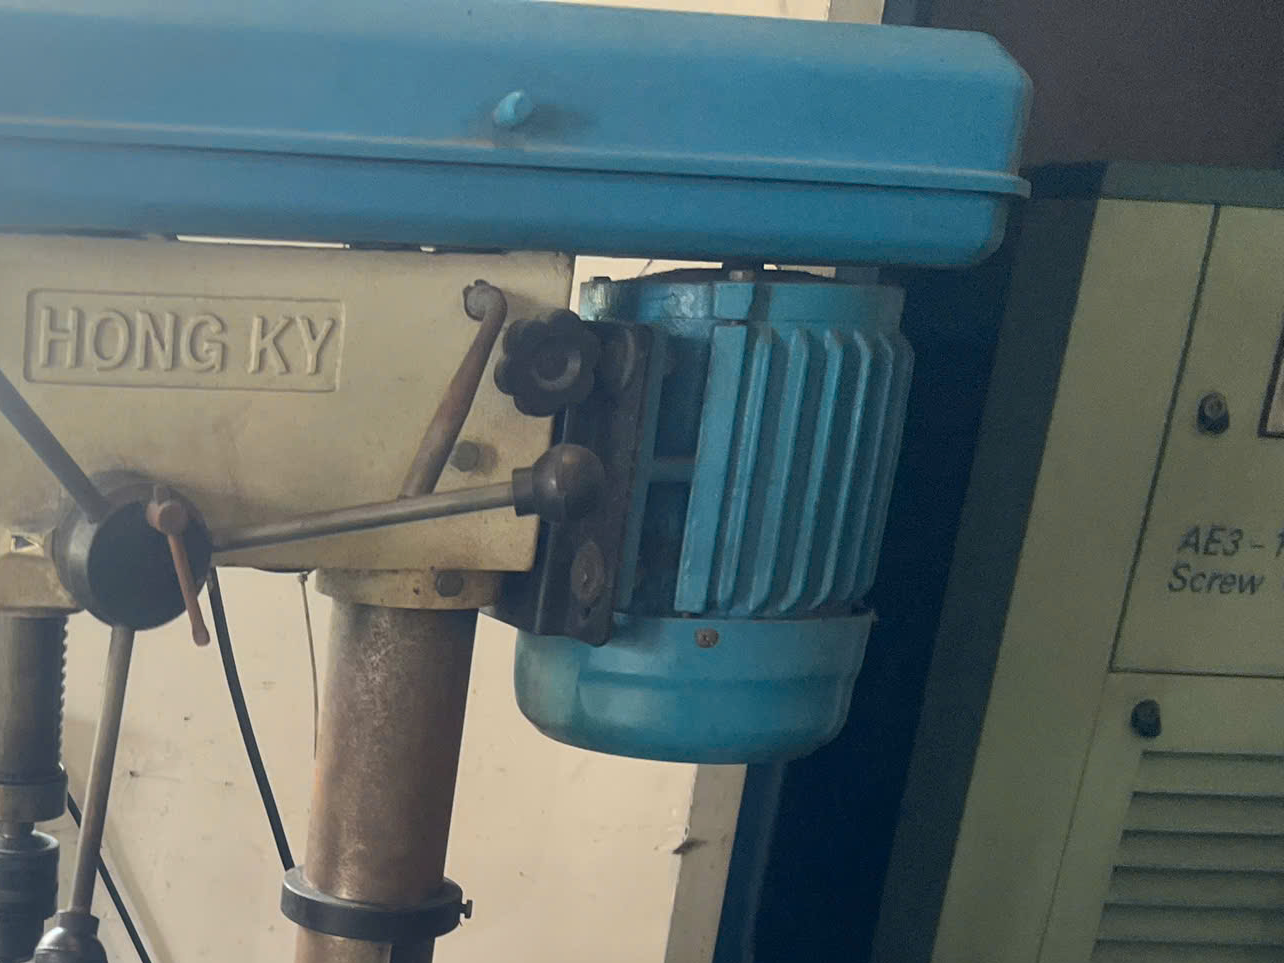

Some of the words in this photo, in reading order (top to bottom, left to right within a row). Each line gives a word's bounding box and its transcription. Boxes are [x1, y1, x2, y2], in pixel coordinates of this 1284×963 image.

[38, 305, 229, 374] HONG
[247, 314, 336, 376] KY
[1167, 561, 1265, 595] Screw
